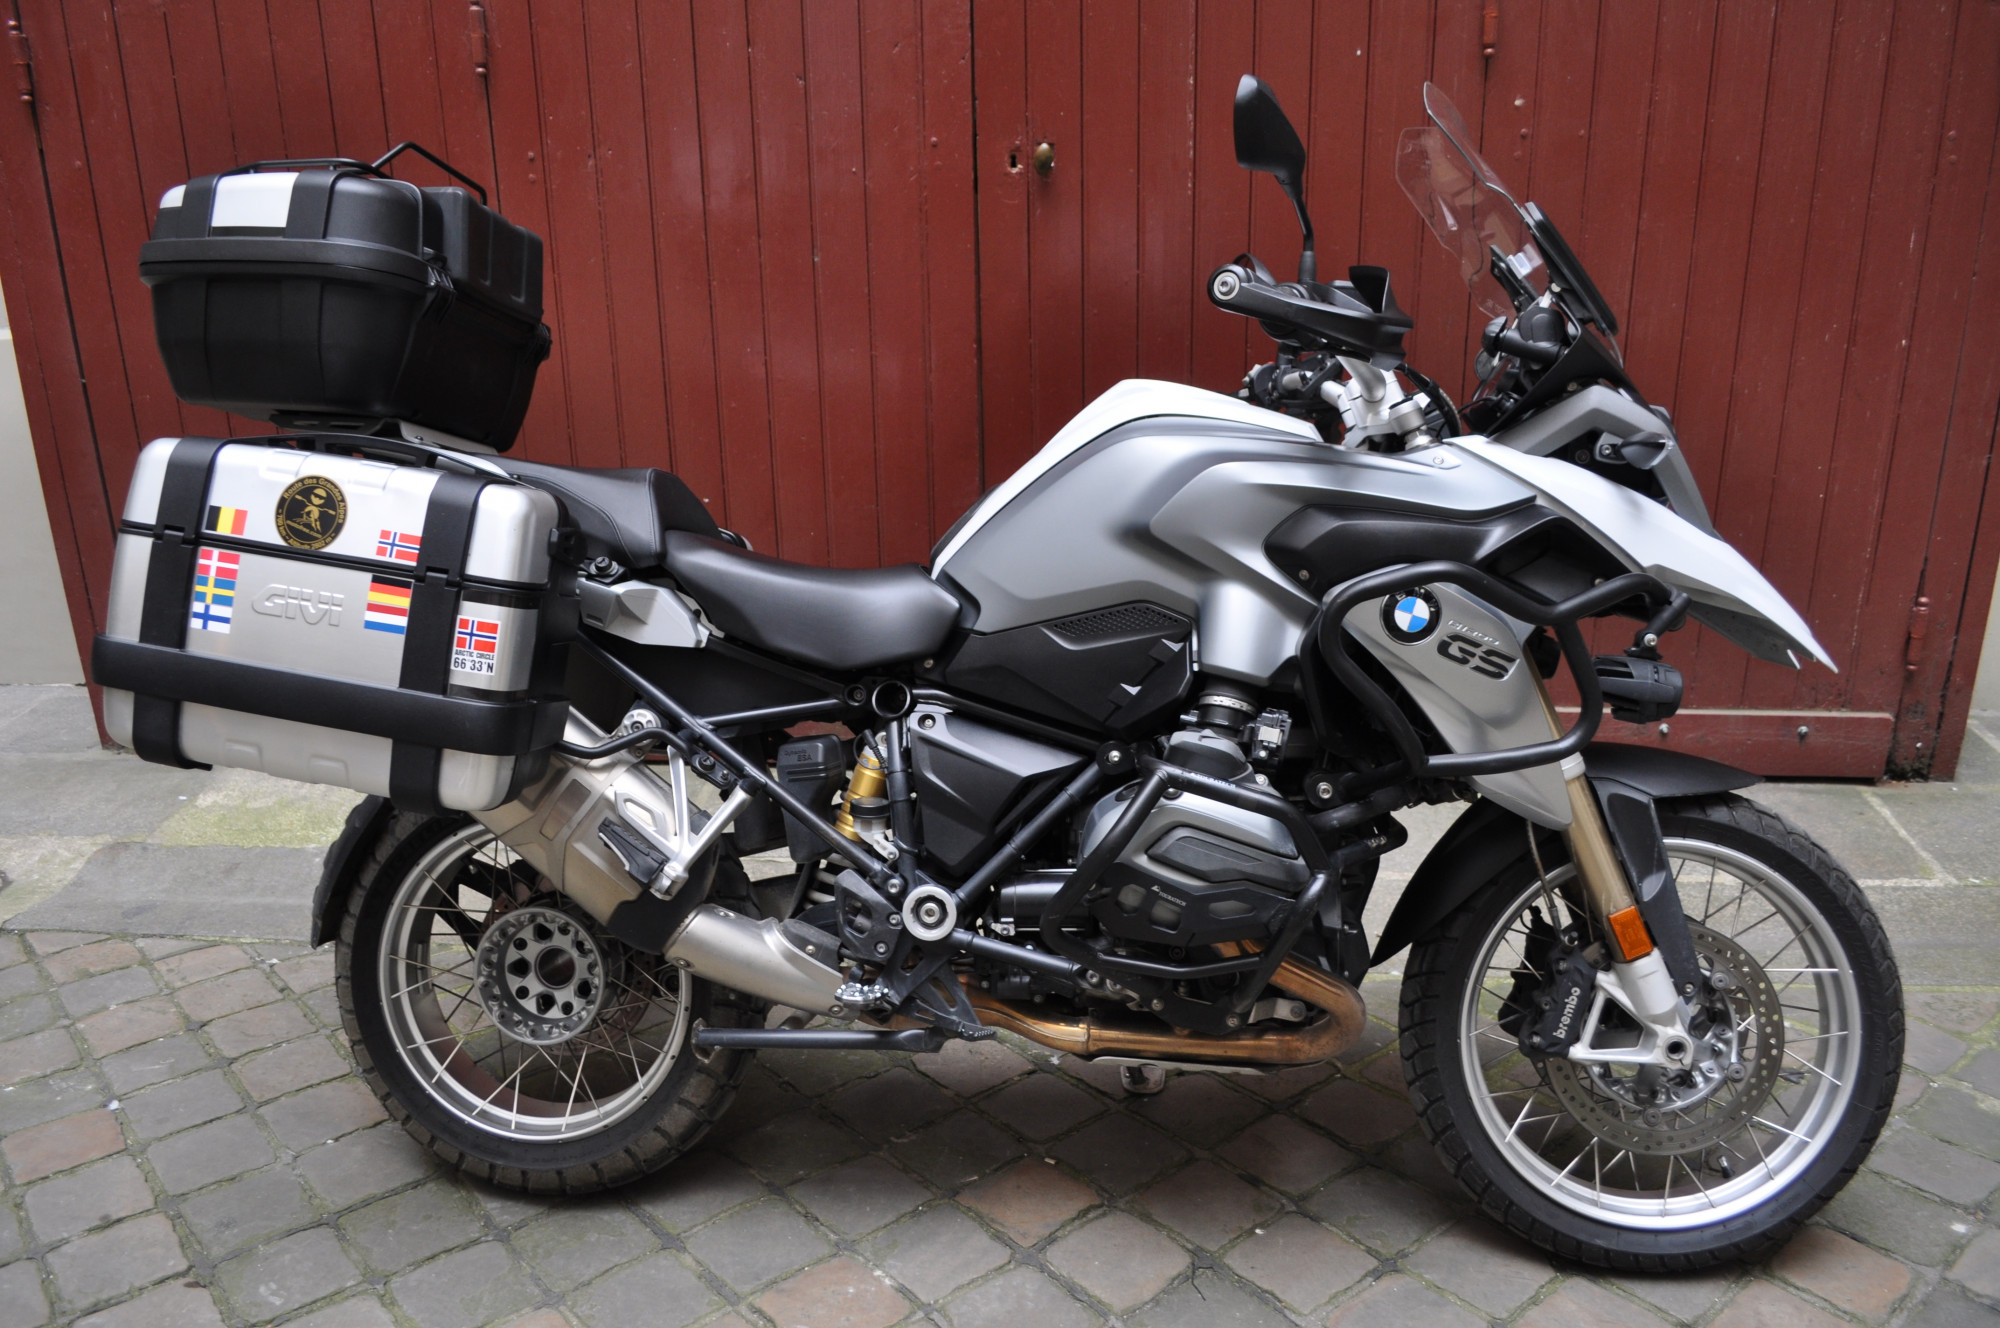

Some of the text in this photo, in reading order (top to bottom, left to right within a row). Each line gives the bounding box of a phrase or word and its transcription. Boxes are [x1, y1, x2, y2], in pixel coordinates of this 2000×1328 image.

[283, 481, 303, 499] Route
[319, 478, 342, 501] Grandes
[251, 583, 345, 627] GIVI
[454, 649, 496, 661] ARCTIC CIRCLE
[1437, 632, 1519, 681] GS
[1552, 986, 1581, 1039] brembo
